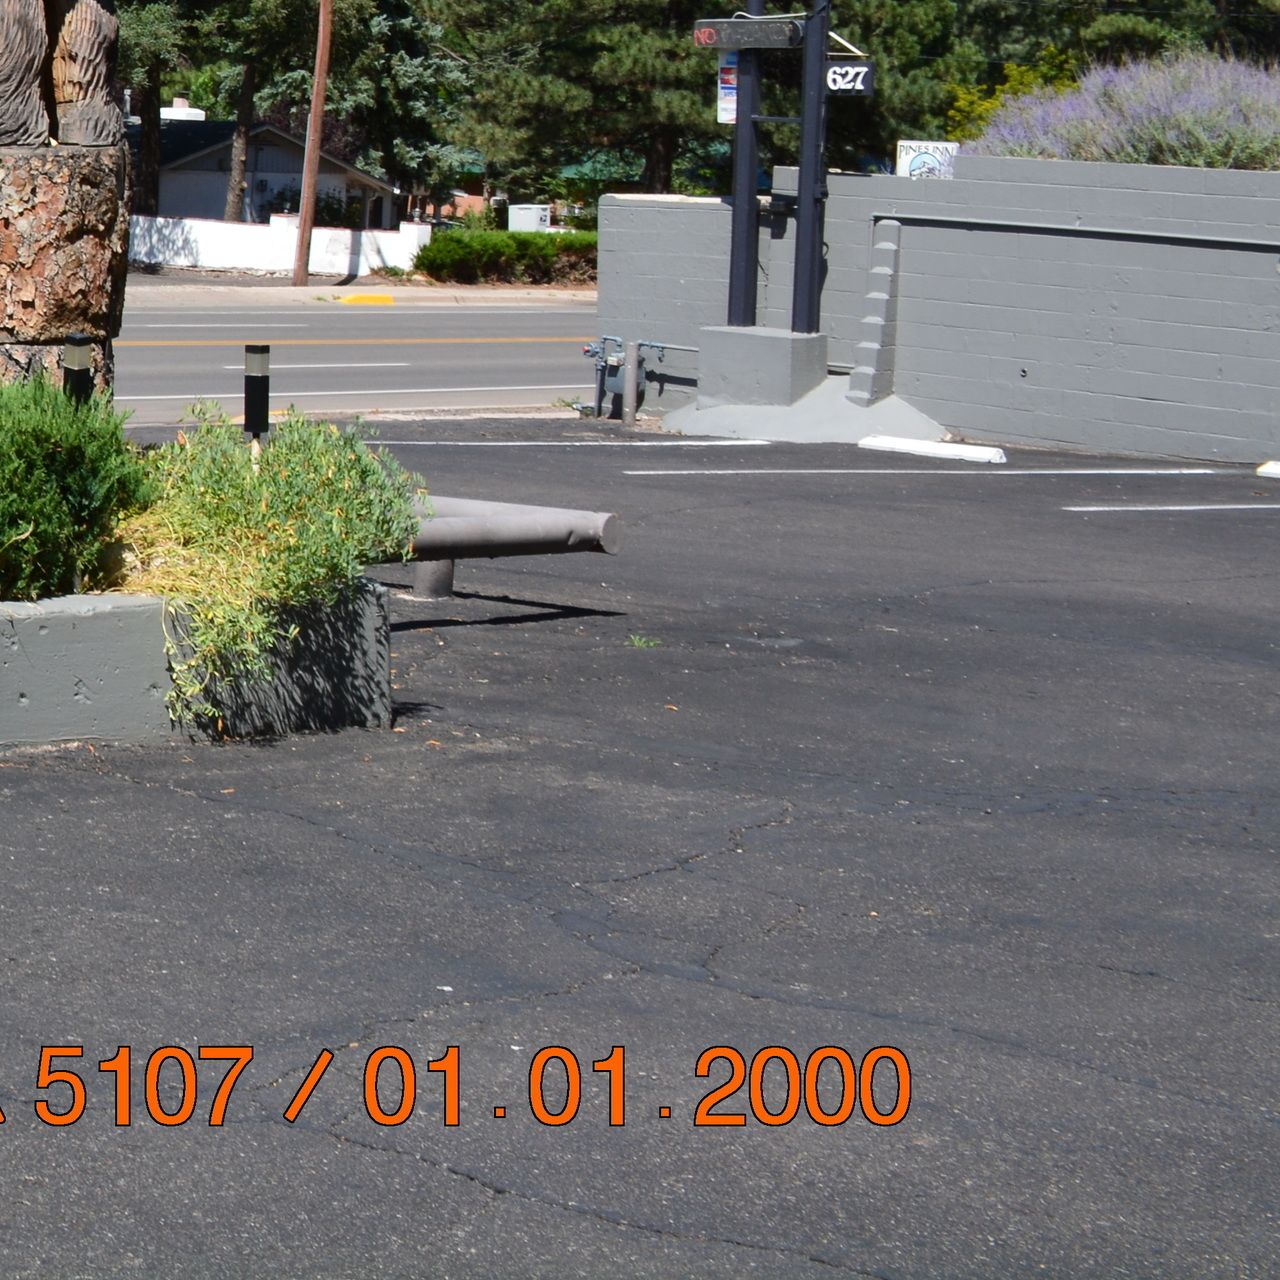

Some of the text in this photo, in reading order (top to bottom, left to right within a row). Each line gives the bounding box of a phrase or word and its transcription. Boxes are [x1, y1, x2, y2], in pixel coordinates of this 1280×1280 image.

[694, 27, 716, 47] NO
[826, 66, 869, 90] 627
[899, 144, 955, 159] PINES INN
